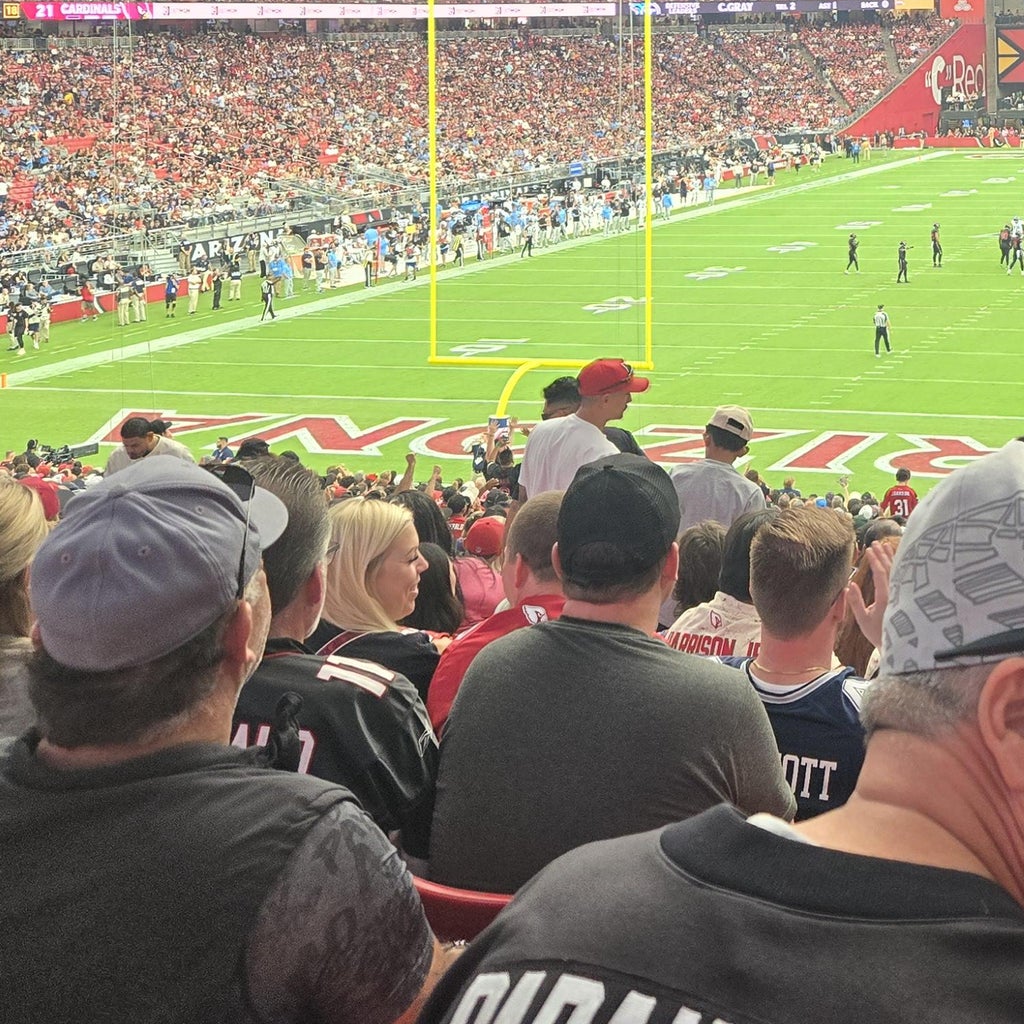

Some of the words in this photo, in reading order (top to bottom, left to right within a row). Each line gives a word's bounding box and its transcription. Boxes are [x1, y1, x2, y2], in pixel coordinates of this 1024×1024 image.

[35, 4, 54, 17] 21
[61, 2, 121, 15] CARDINALS
[717, 2, 753, 12] C.GRAY
[789, 2, 796, 10] 2
[952, 52, 986, 97] Red
[893, 498, 910, 517] 31
[316, 654, 395, 698] 11
[779, 752, 838, 801] OTT
